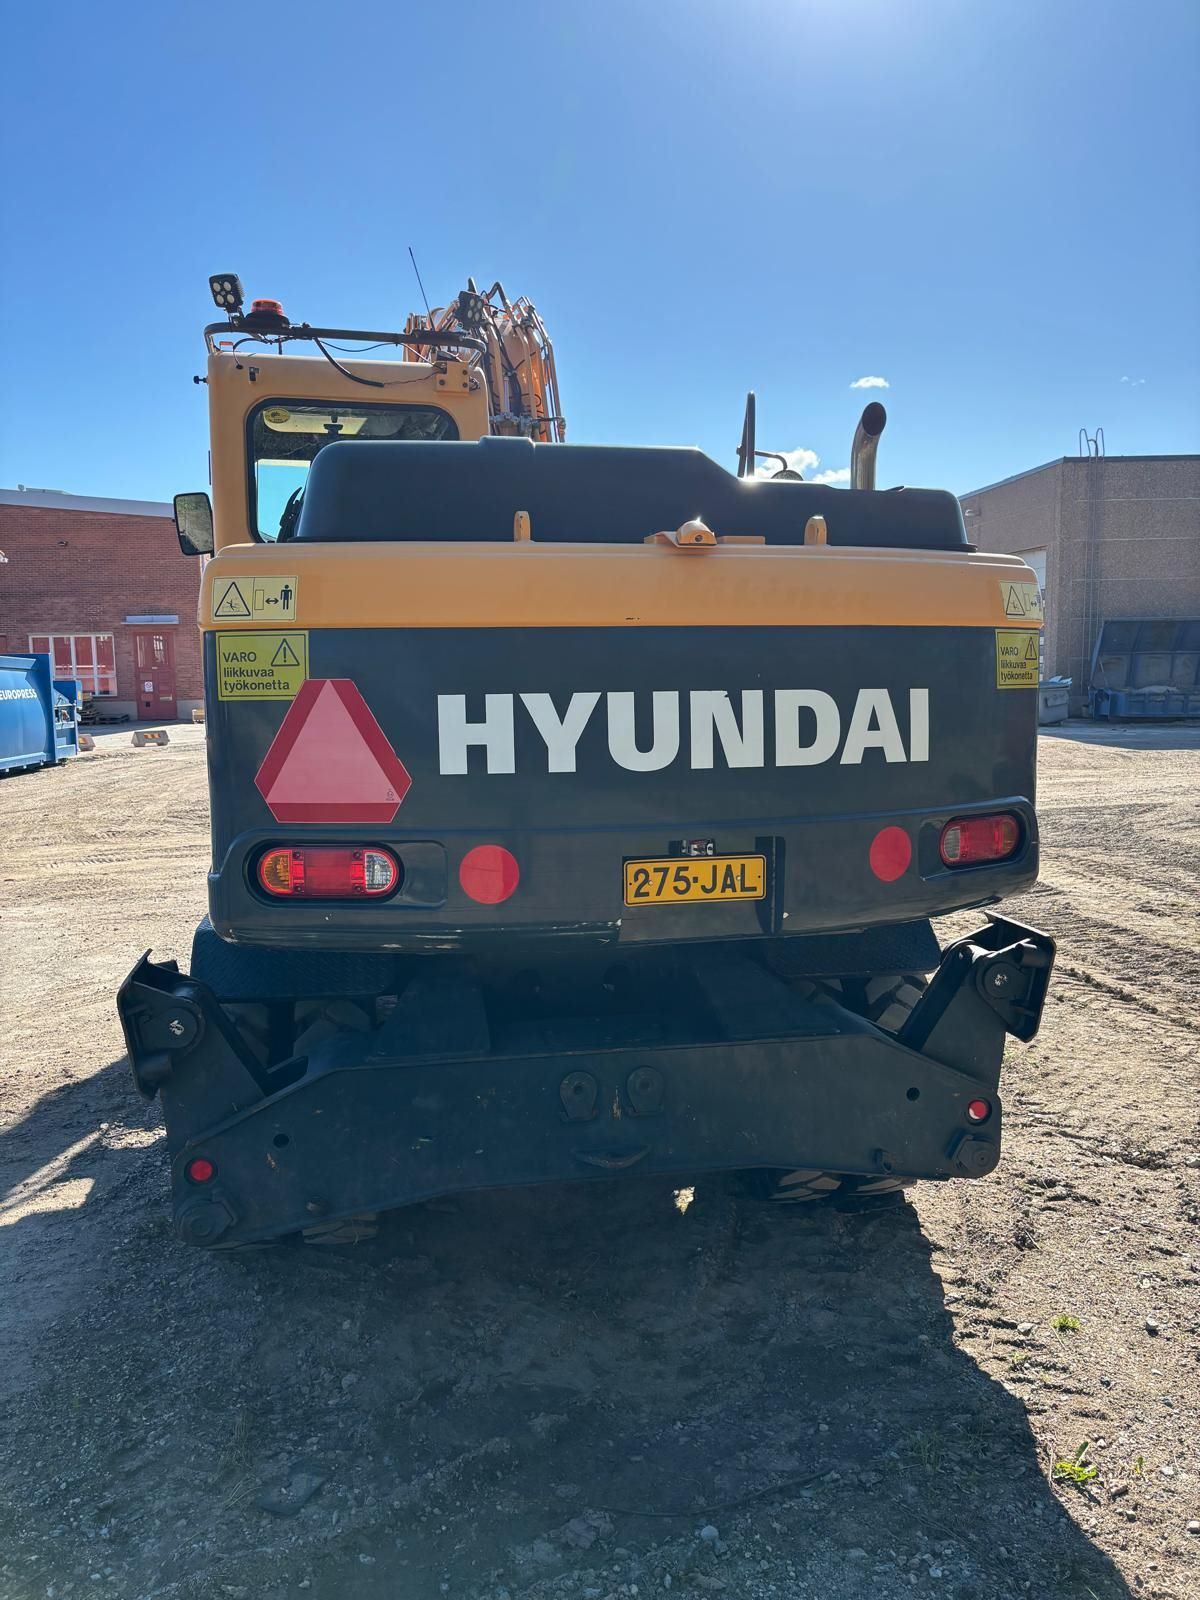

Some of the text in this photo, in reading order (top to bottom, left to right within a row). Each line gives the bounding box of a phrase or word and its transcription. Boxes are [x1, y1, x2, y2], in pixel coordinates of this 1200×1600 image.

[222, 651, 257, 663] VARO
[1000, 646, 1019, 656] VARO
[223, 667, 274, 678] liikkuvaa
[1001, 671, 1033, 683] työkonetta
[224, 680, 289, 693] työkonetta
[437, 687, 930, 775] HYUNDAI
[633, 863, 757, 898] 275-JAL
